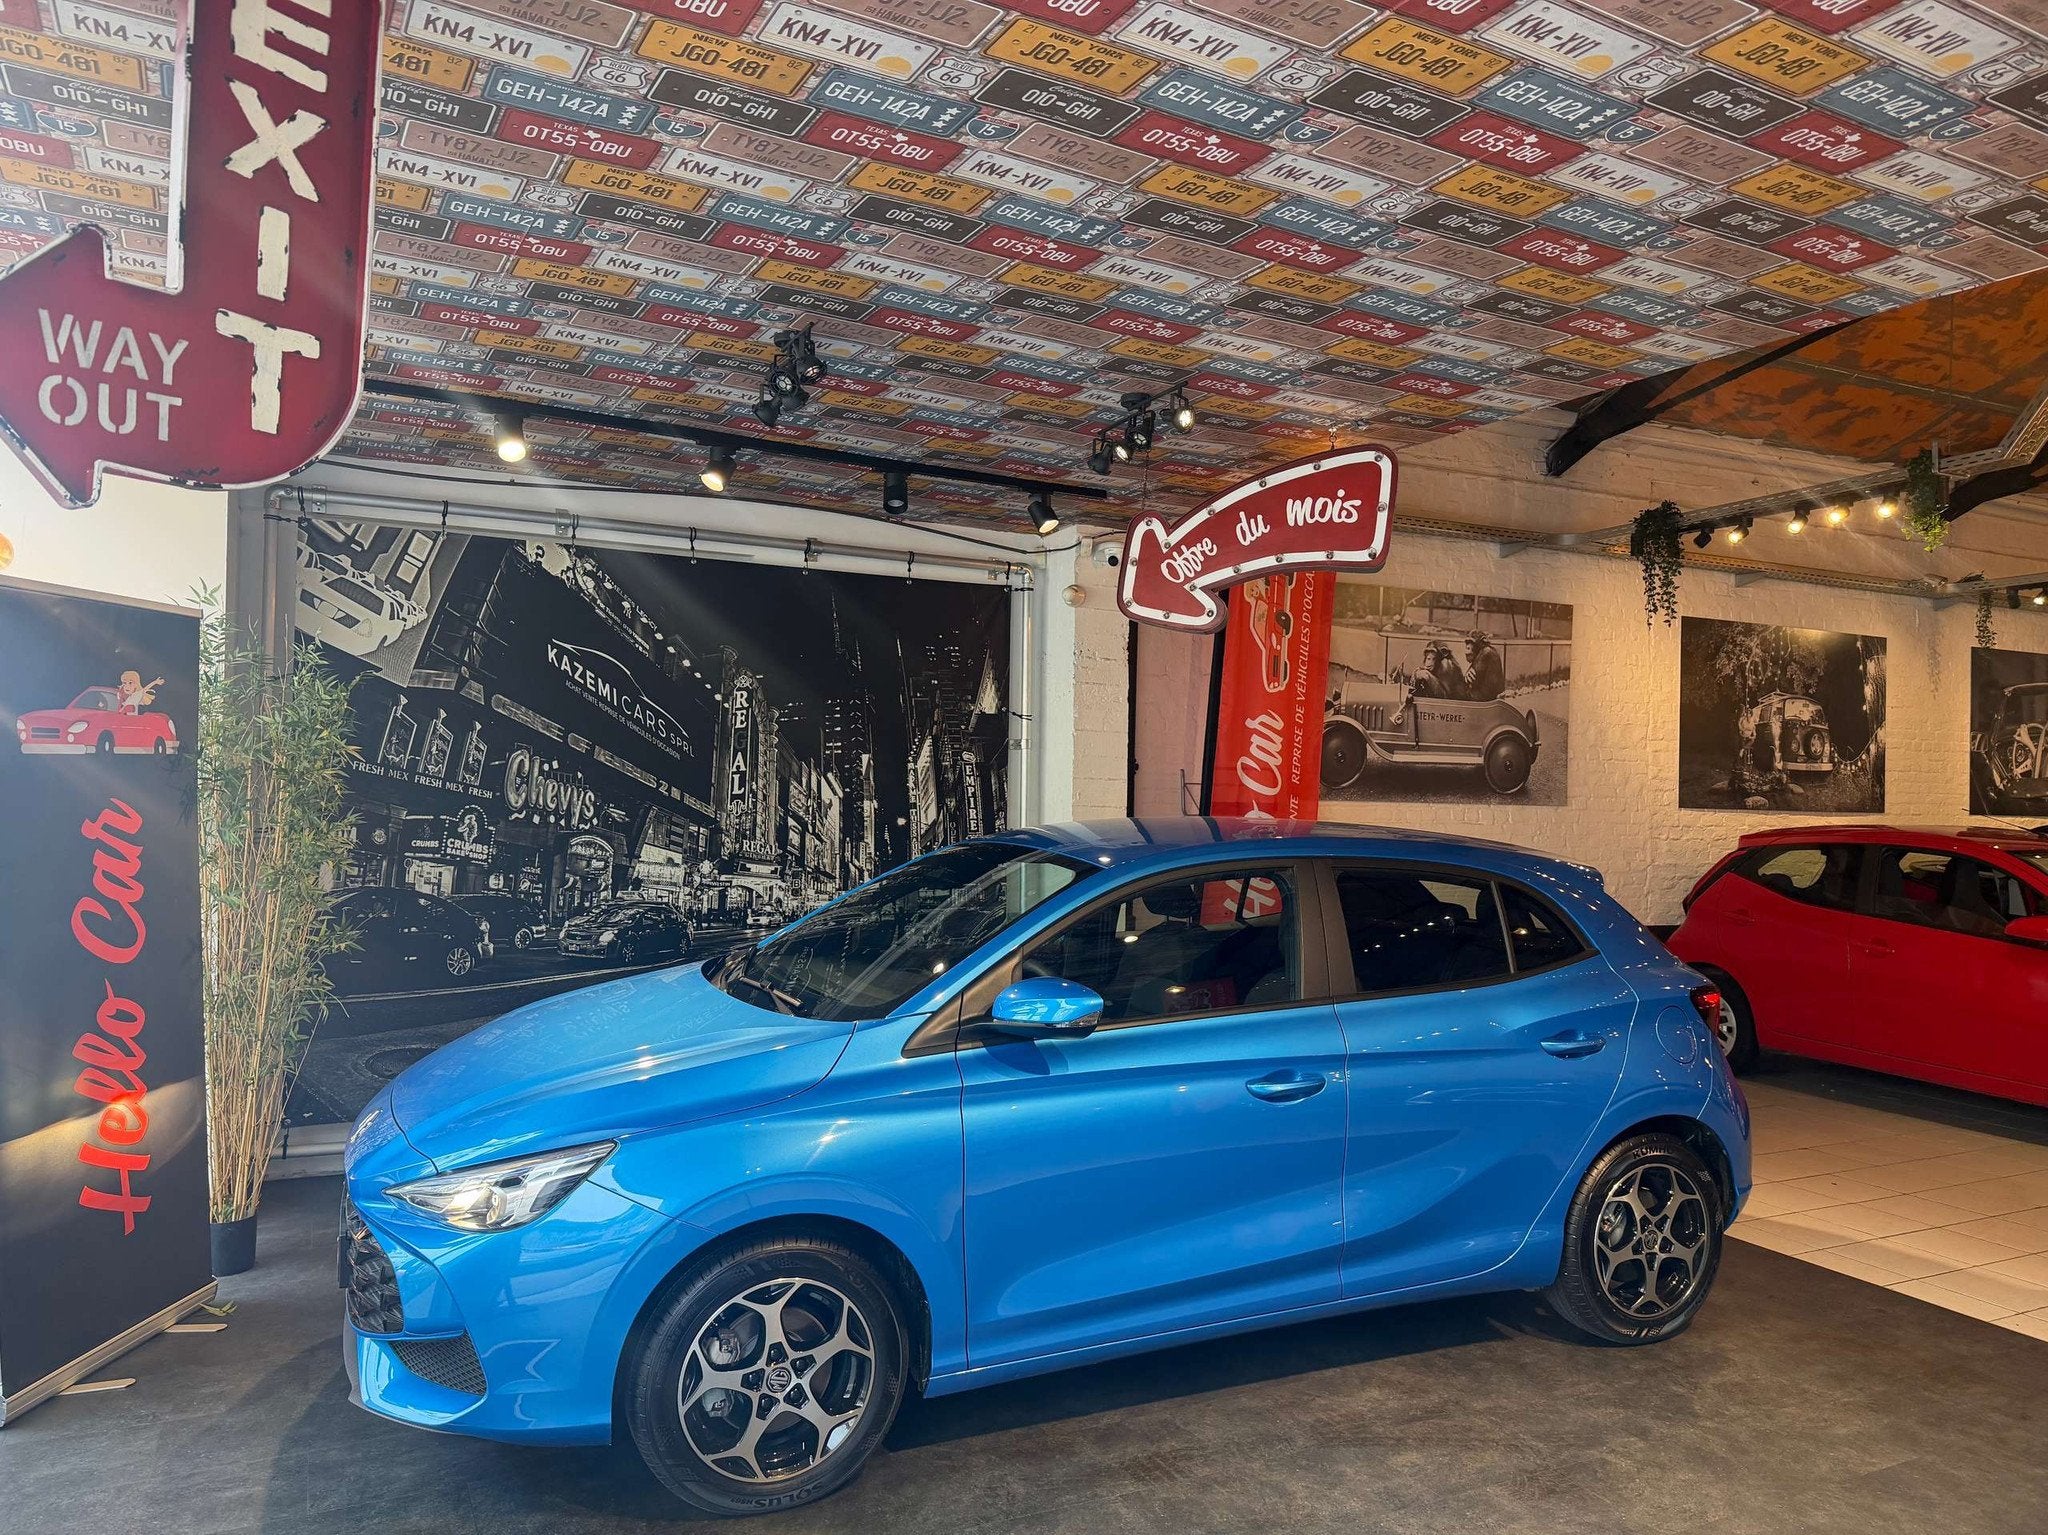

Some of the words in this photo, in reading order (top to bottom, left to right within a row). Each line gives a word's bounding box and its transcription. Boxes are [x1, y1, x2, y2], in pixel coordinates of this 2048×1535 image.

[423, 14, 533, 58] KN4-XV1
[692, 33, 729, 48] NEW
[736, 45, 777, 61] YORK
[777, 17, 883, 60] KN4-XV1
[1048, 32, 1084, 46] NEW
[1089, 43, 1126, 60] YORK
[1138, 17, 1239, 61] KN4-XV1
[1412, 31, 1446, 46] NEW
[1446, 42, 1482, 59] YORK
[1504, 14, 1602, 59] KN4-XV1
[1781, 31, 1814, 46] NEW
[1810, 43, 1844, 60] YORK
[1877, 14, 1971, 57] KN4-XV1
[603, 70, 626, 83] 66
[939, 71, 964, 84] 66
[1281, 72, 1308, 85] 66
[1628, 70, 1658, 84] 66
[1981, 67, 2012, 81] 66
[496, 79, 609, 118] GEH-142A
[825, 82, 931, 120] GEH-142A
[1158, 81, 1259, 122] GEH-142A
[1497, 80, 1592, 121] GEH-142A
[1841, 80, 1931, 120] GEH-142A
[667, 122, 687, 134] 15
[978, 123, 1000, 136] 15
[1294, 126, 1319, 139] 15
[1615, 126, 1643, 138] 15
[387, 157, 477, 187] KN4-XV1
[676, 158, 764, 188] KN4-XV1
[969, 159, 1054, 190] KN4-XV1
[1267, 163, 1349, 192] KN4-XV1
[1568, 163, 1648, 192] KN4-XV1
[215, 0, 332, 434] EXIT
[450, 201, 544, 228] GEH-142A
[721, 202, 812, 230] GEH-142A
[1668, 199, 1692, 209] 66
[1844, 203, 1919, 232] GEH-142A
[996, 204, 1083, 234] GEH-142A
[1275, 206, 1358, 236] GEH-142A
[1557, 206, 1636, 235] GEH-142A
[1653, 237, 1677, 247] 15
[606, 257, 681, 279] KN4-XV1
[853, 259, 926, 282] KN4-XV1
[1103, 262, 1174, 284] KN4-XV1
[1356, 264, 1425, 285] KN4-XV1
[1872, 263, 1938, 285] KN4-XV1
[1358, 294, 1428, 316] GEH-142A
[38, 307, 189, 386] WAY
[1421, 338, 1481, 354] KN4-XV1
[38, 374, 182, 441] OUT
[1236, 511, 1270, 546] du
[1286, 489, 1361, 526] mois
[1296, 627, 1311, 700] VÉHICULES
[547, 644, 618, 706] KAZEMI
[621, 695, 666, 737] CARS
[670, 732, 695, 757] SPRL
[583, 689, 598, 706] VENTE
[599, 701, 618, 719] REPRISE
[1294, 705, 1305, 724] DE
[731, 690, 750, 795] REGAL
[1236, 709, 1284, 795] Car
[1291, 726, 1303, 784] REPRISE
[352, 761, 384, 778] FRESH
[388, 769, 409, 781] MEX
[414, 775, 443, 789] FRESH
[445, 781, 465, 793] MEX
[468, 786, 493, 799] FRESH
[965, 765, 978, 831] EMPIRE
[411, 840, 440, 848] CRUMBS
[447, 838, 489, 854] CRUMBS
[742, 840, 777, 855] REGAL
[70, 797, 146, 964] Car
[72, 978, 151, 1235] Hello
